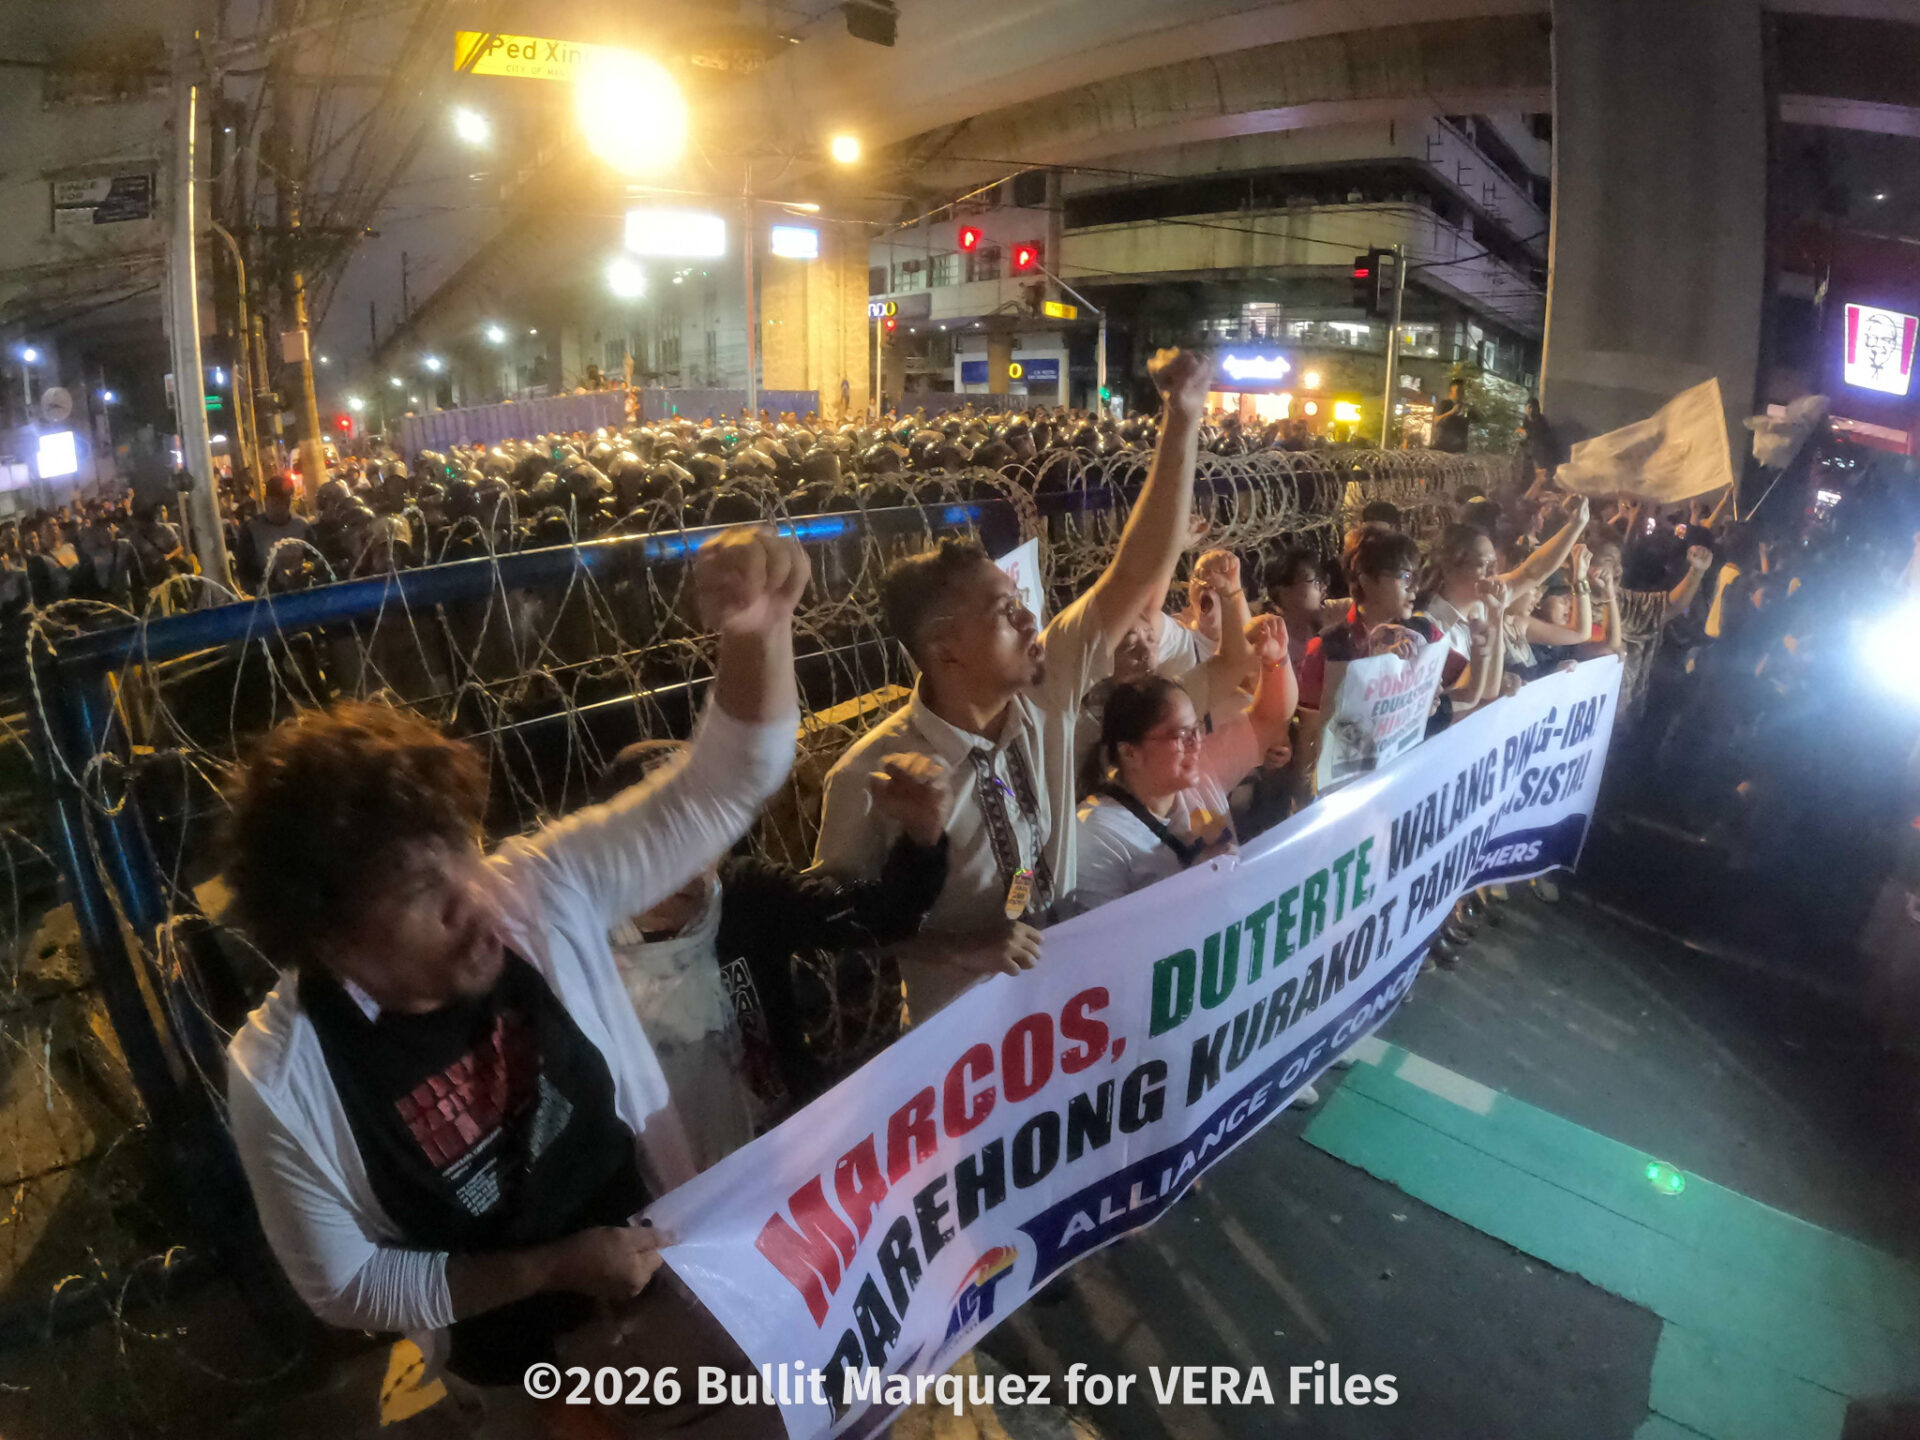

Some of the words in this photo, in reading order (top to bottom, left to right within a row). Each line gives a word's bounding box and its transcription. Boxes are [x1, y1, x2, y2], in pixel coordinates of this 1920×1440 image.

[488, 37, 537, 60] Ped
[545, 42, 589, 66] Xin
[755, 986, 1127, 1329] MARCOS,
[1387, 747, 1498, 882] WALANG
[821, 1060, 1168, 1429] PAREHONG
[1186, 895, 1398, 1107] KURAKOT,
[1057, 1088, 1269, 1248] ALLIANCE
[1278, 1037, 1328, 1089] OF
